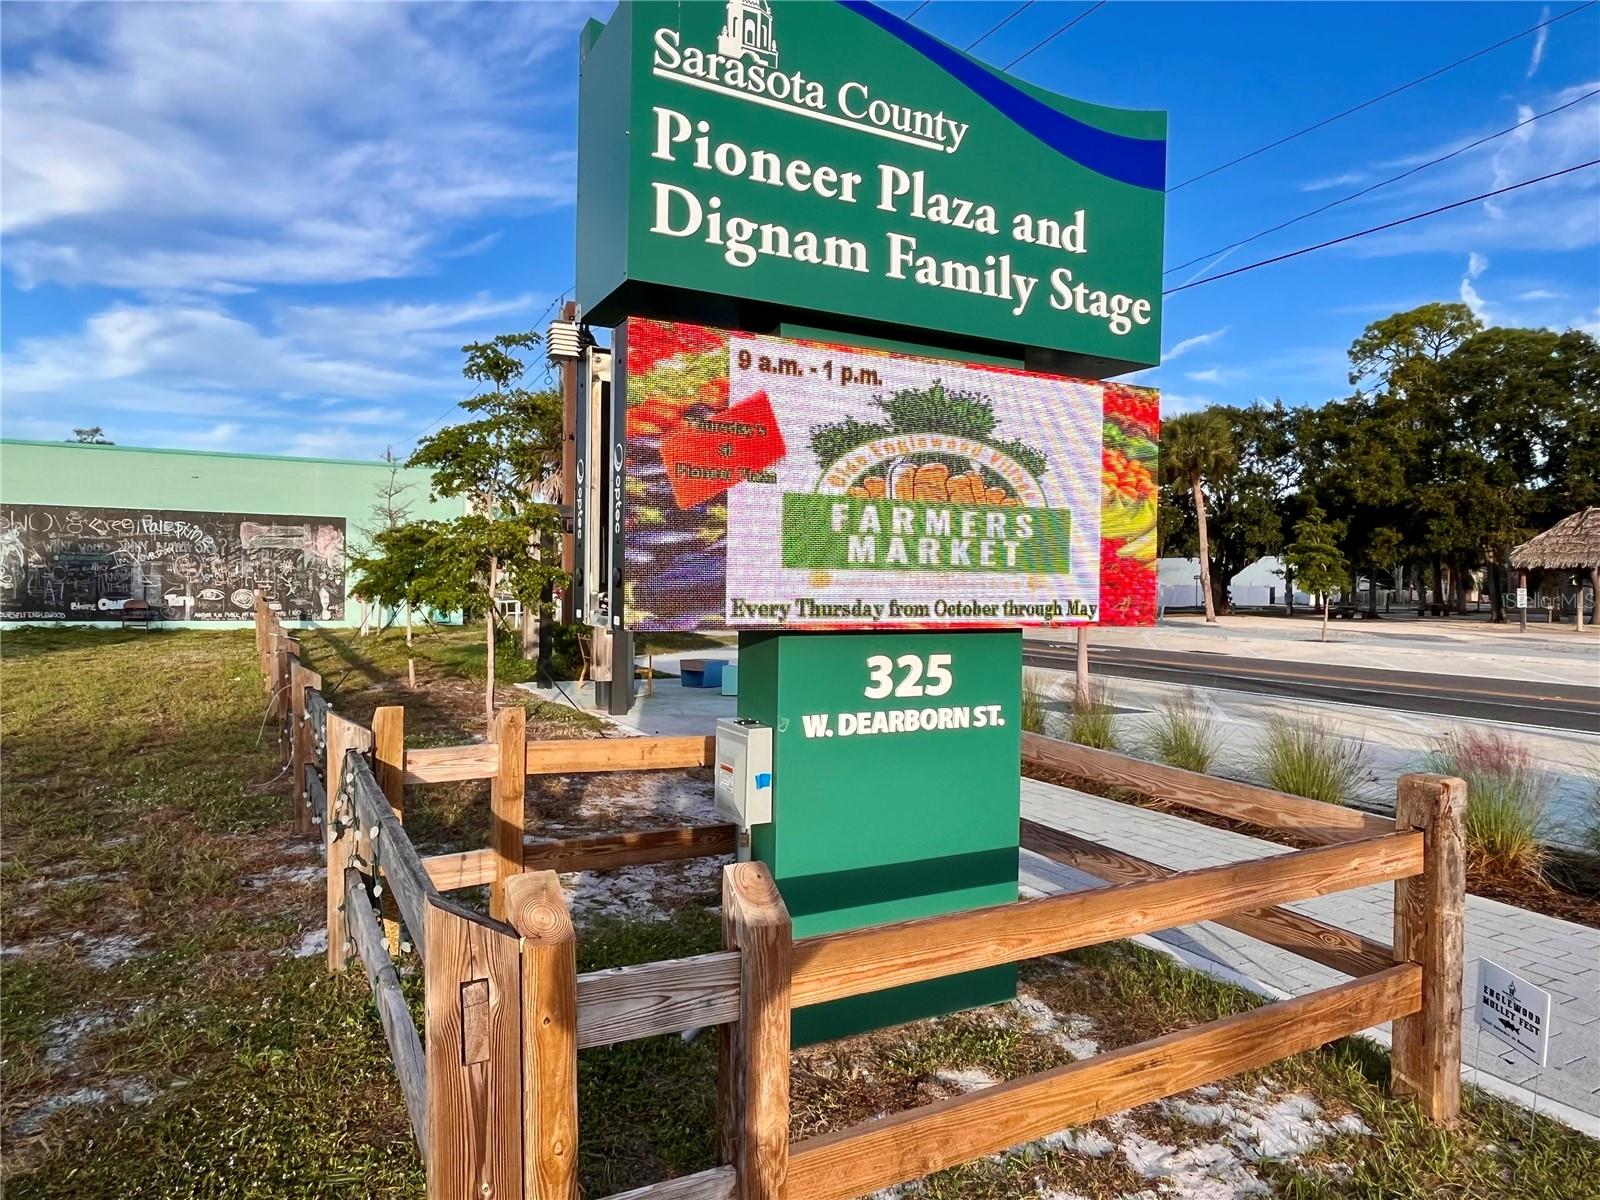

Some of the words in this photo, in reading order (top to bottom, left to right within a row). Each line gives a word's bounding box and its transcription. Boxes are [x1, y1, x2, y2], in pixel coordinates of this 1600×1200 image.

[652, 26, 827, 111] Sarasota
[837, 81, 970, 154] County
[650, 106, 862, 203] Pioneer
[875, 164, 1000, 235] Plaza
[1012, 210, 1088, 254] and
[650, 182, 870, 268] Dignam
[885, 232, 1039, 316] Family
[1049, 268, 1152, 335] Stage
[738, 349, 752, 370] 9
[758, 356, 803, 377] a.m.
[823, 360, 833, 381] 1
[841, 366, 883, 387] p.m.
[831, 503, 1034, 539] FARMERS
[847, 536, 1020, 567] MARKET
[730, 599, 791, 623] Every
[796, 598, 884, 621] Thursday
[889, 599, 930, 617] from
[934, 599, 999, 618] October
[1002, 599, 1063, 620] through
[1067, 600, 1097, 620] May
[864, 654, 953, 699] 325
[802, 714, 833, 738] W.
[838, 706, 970, 737] DEARBORN
[973, 705, 1005, 728] ST.
[1482, 995, 1516, 1021] MULLET
[1519, 1017, 1541, 1036] FEST
[1483, 984, 1541, 1025] ENGLEWOOD
